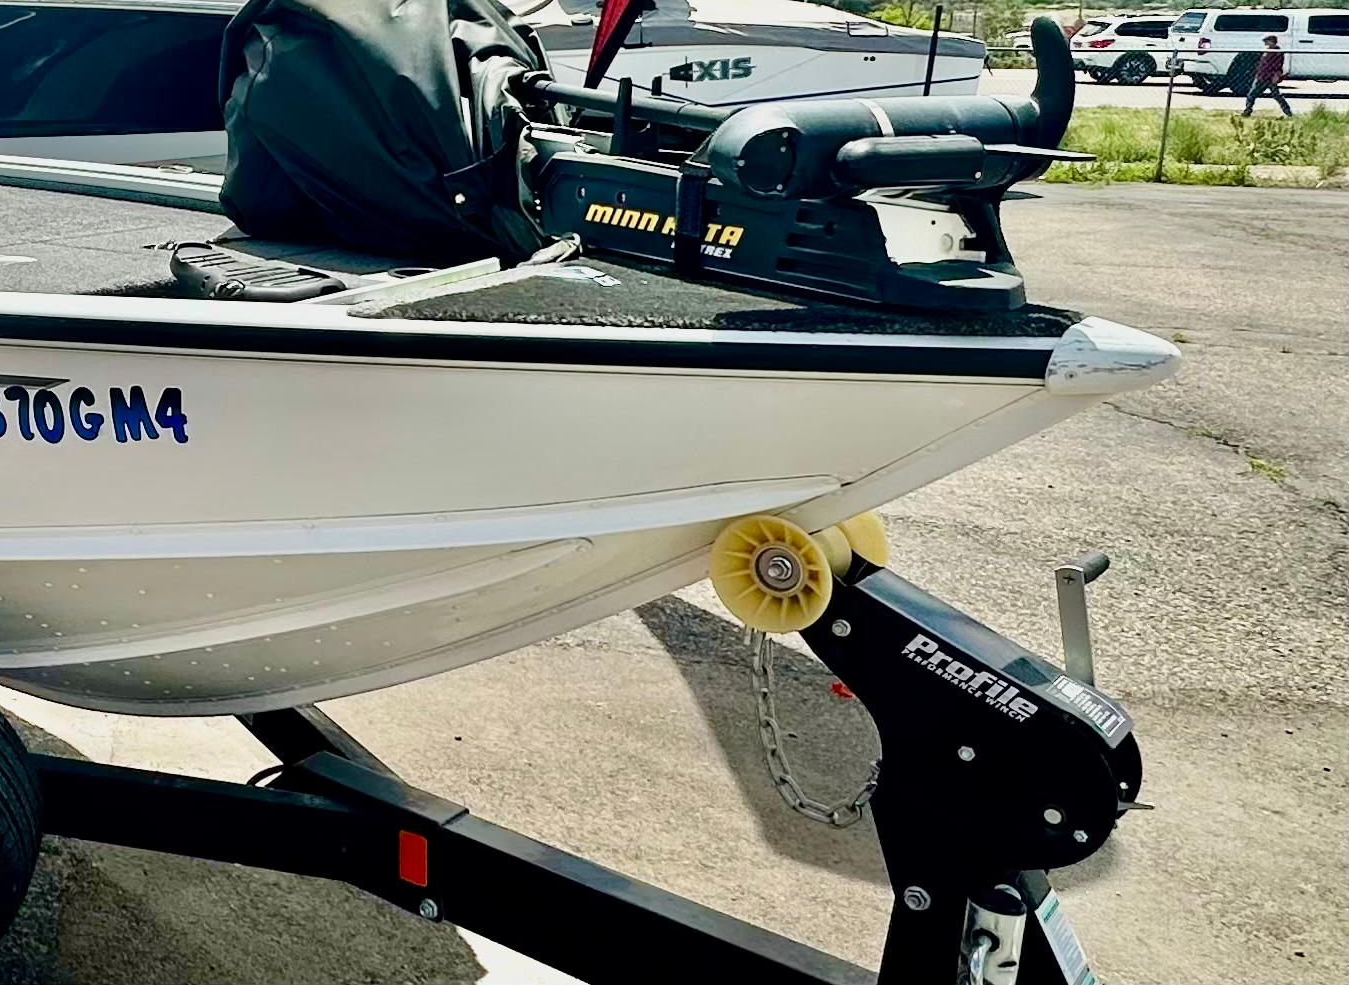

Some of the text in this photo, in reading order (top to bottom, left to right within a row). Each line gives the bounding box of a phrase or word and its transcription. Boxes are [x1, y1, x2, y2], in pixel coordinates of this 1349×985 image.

[585, 203, 744, 247] MINN KTA
[900, 649, 983, 698] PERFORMANCE
[983, 691, 1031, 723] WINCH
[904, 633, 1040, 717] Profile
